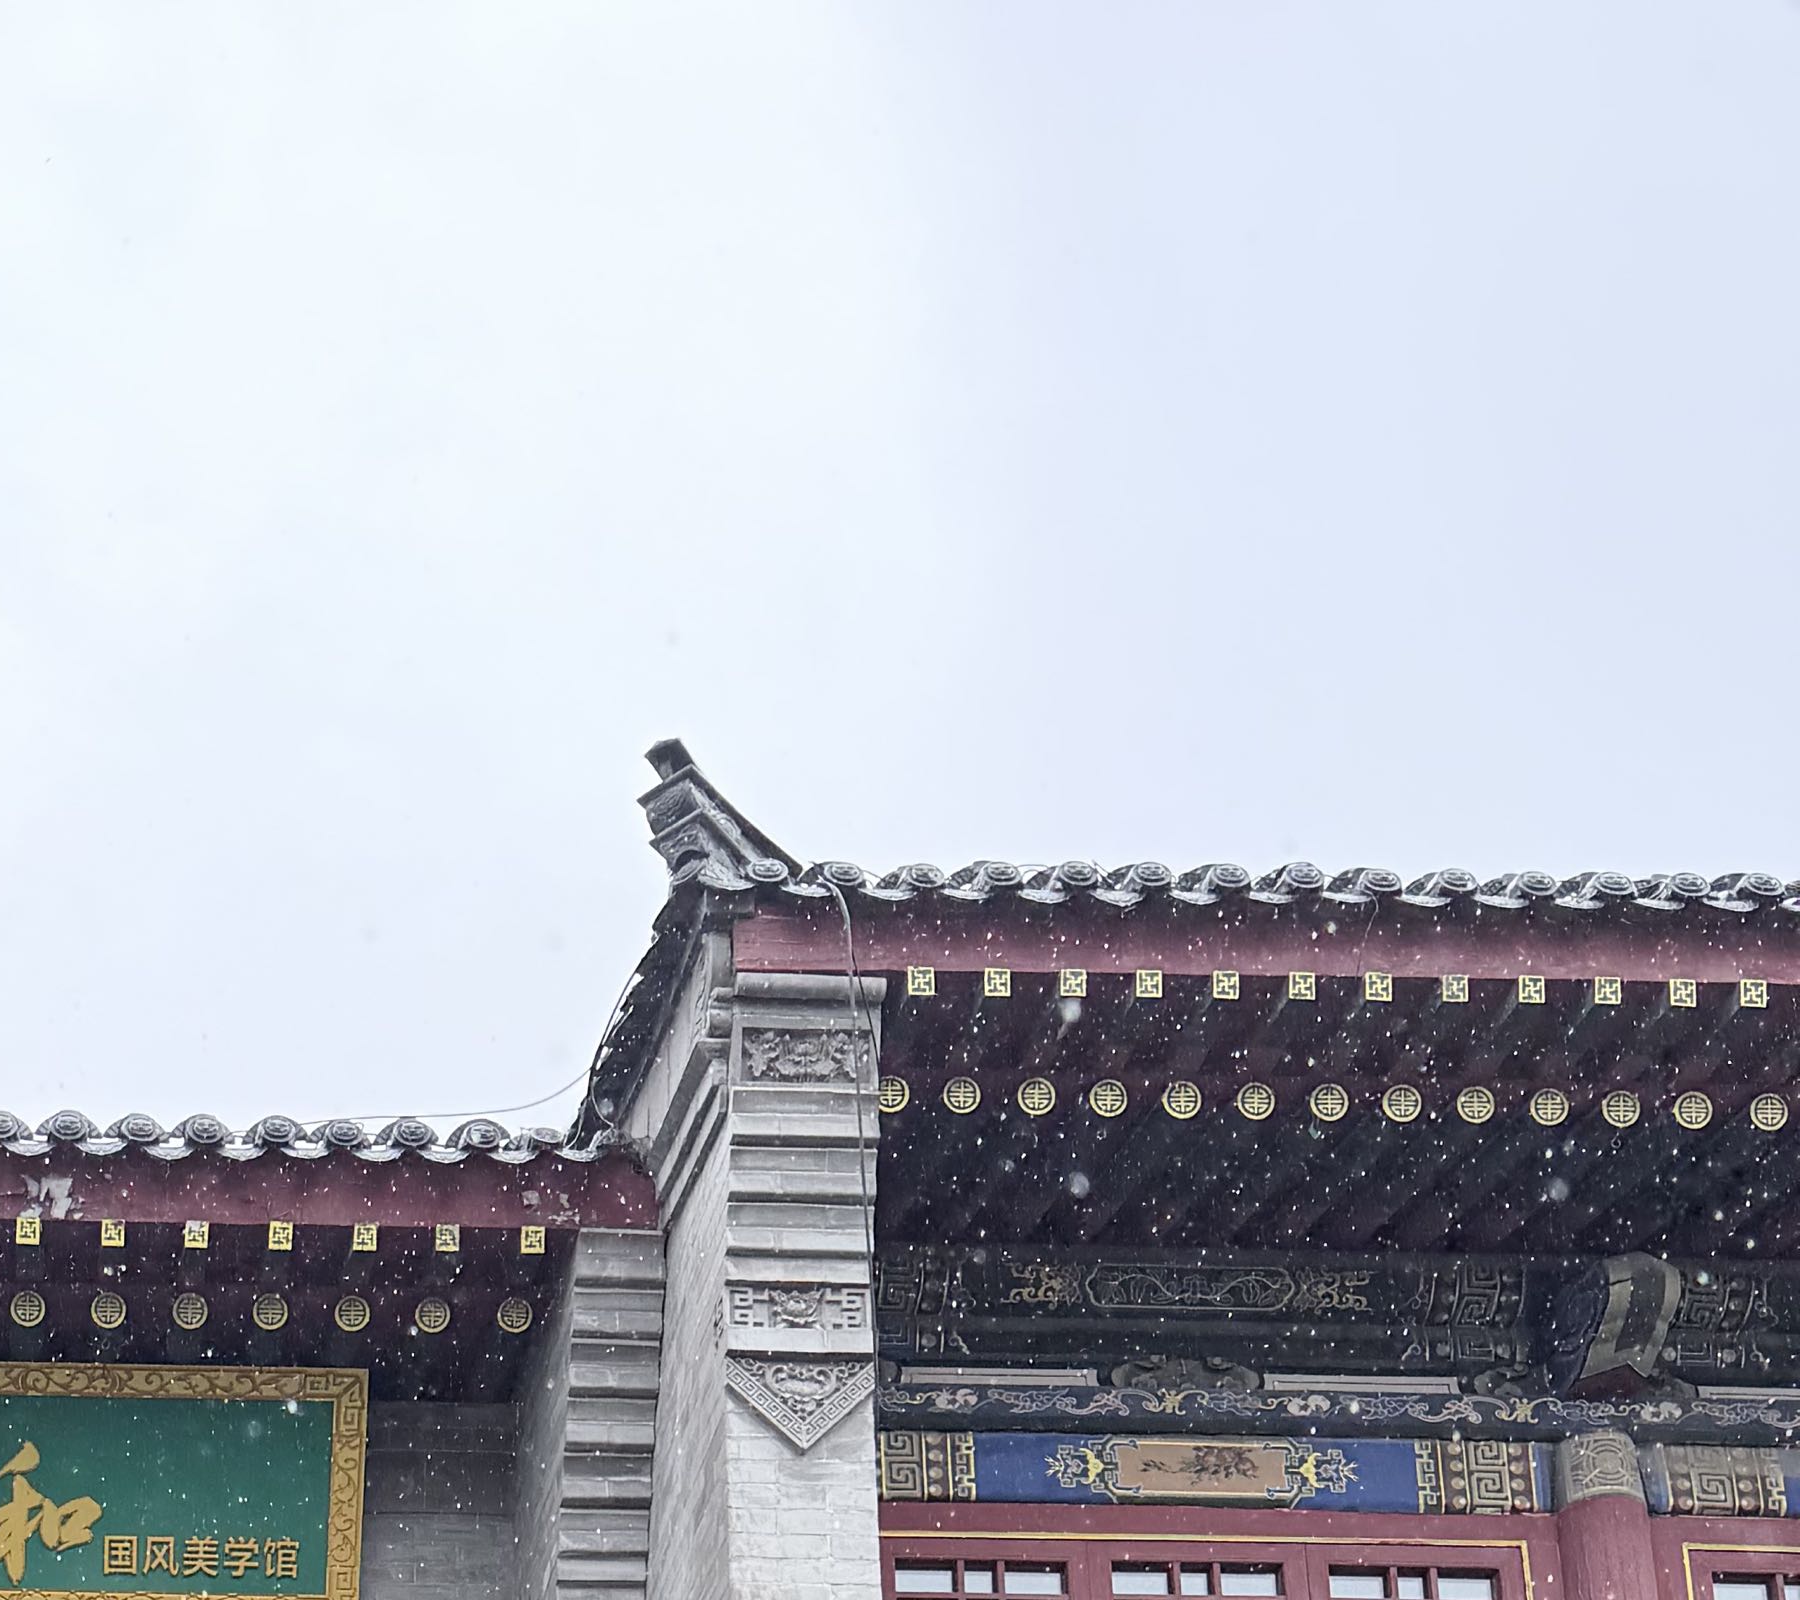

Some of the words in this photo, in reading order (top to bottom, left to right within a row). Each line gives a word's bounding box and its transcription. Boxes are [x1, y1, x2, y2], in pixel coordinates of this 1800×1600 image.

[102, 1534, 301, 1579] 国风美学馆
